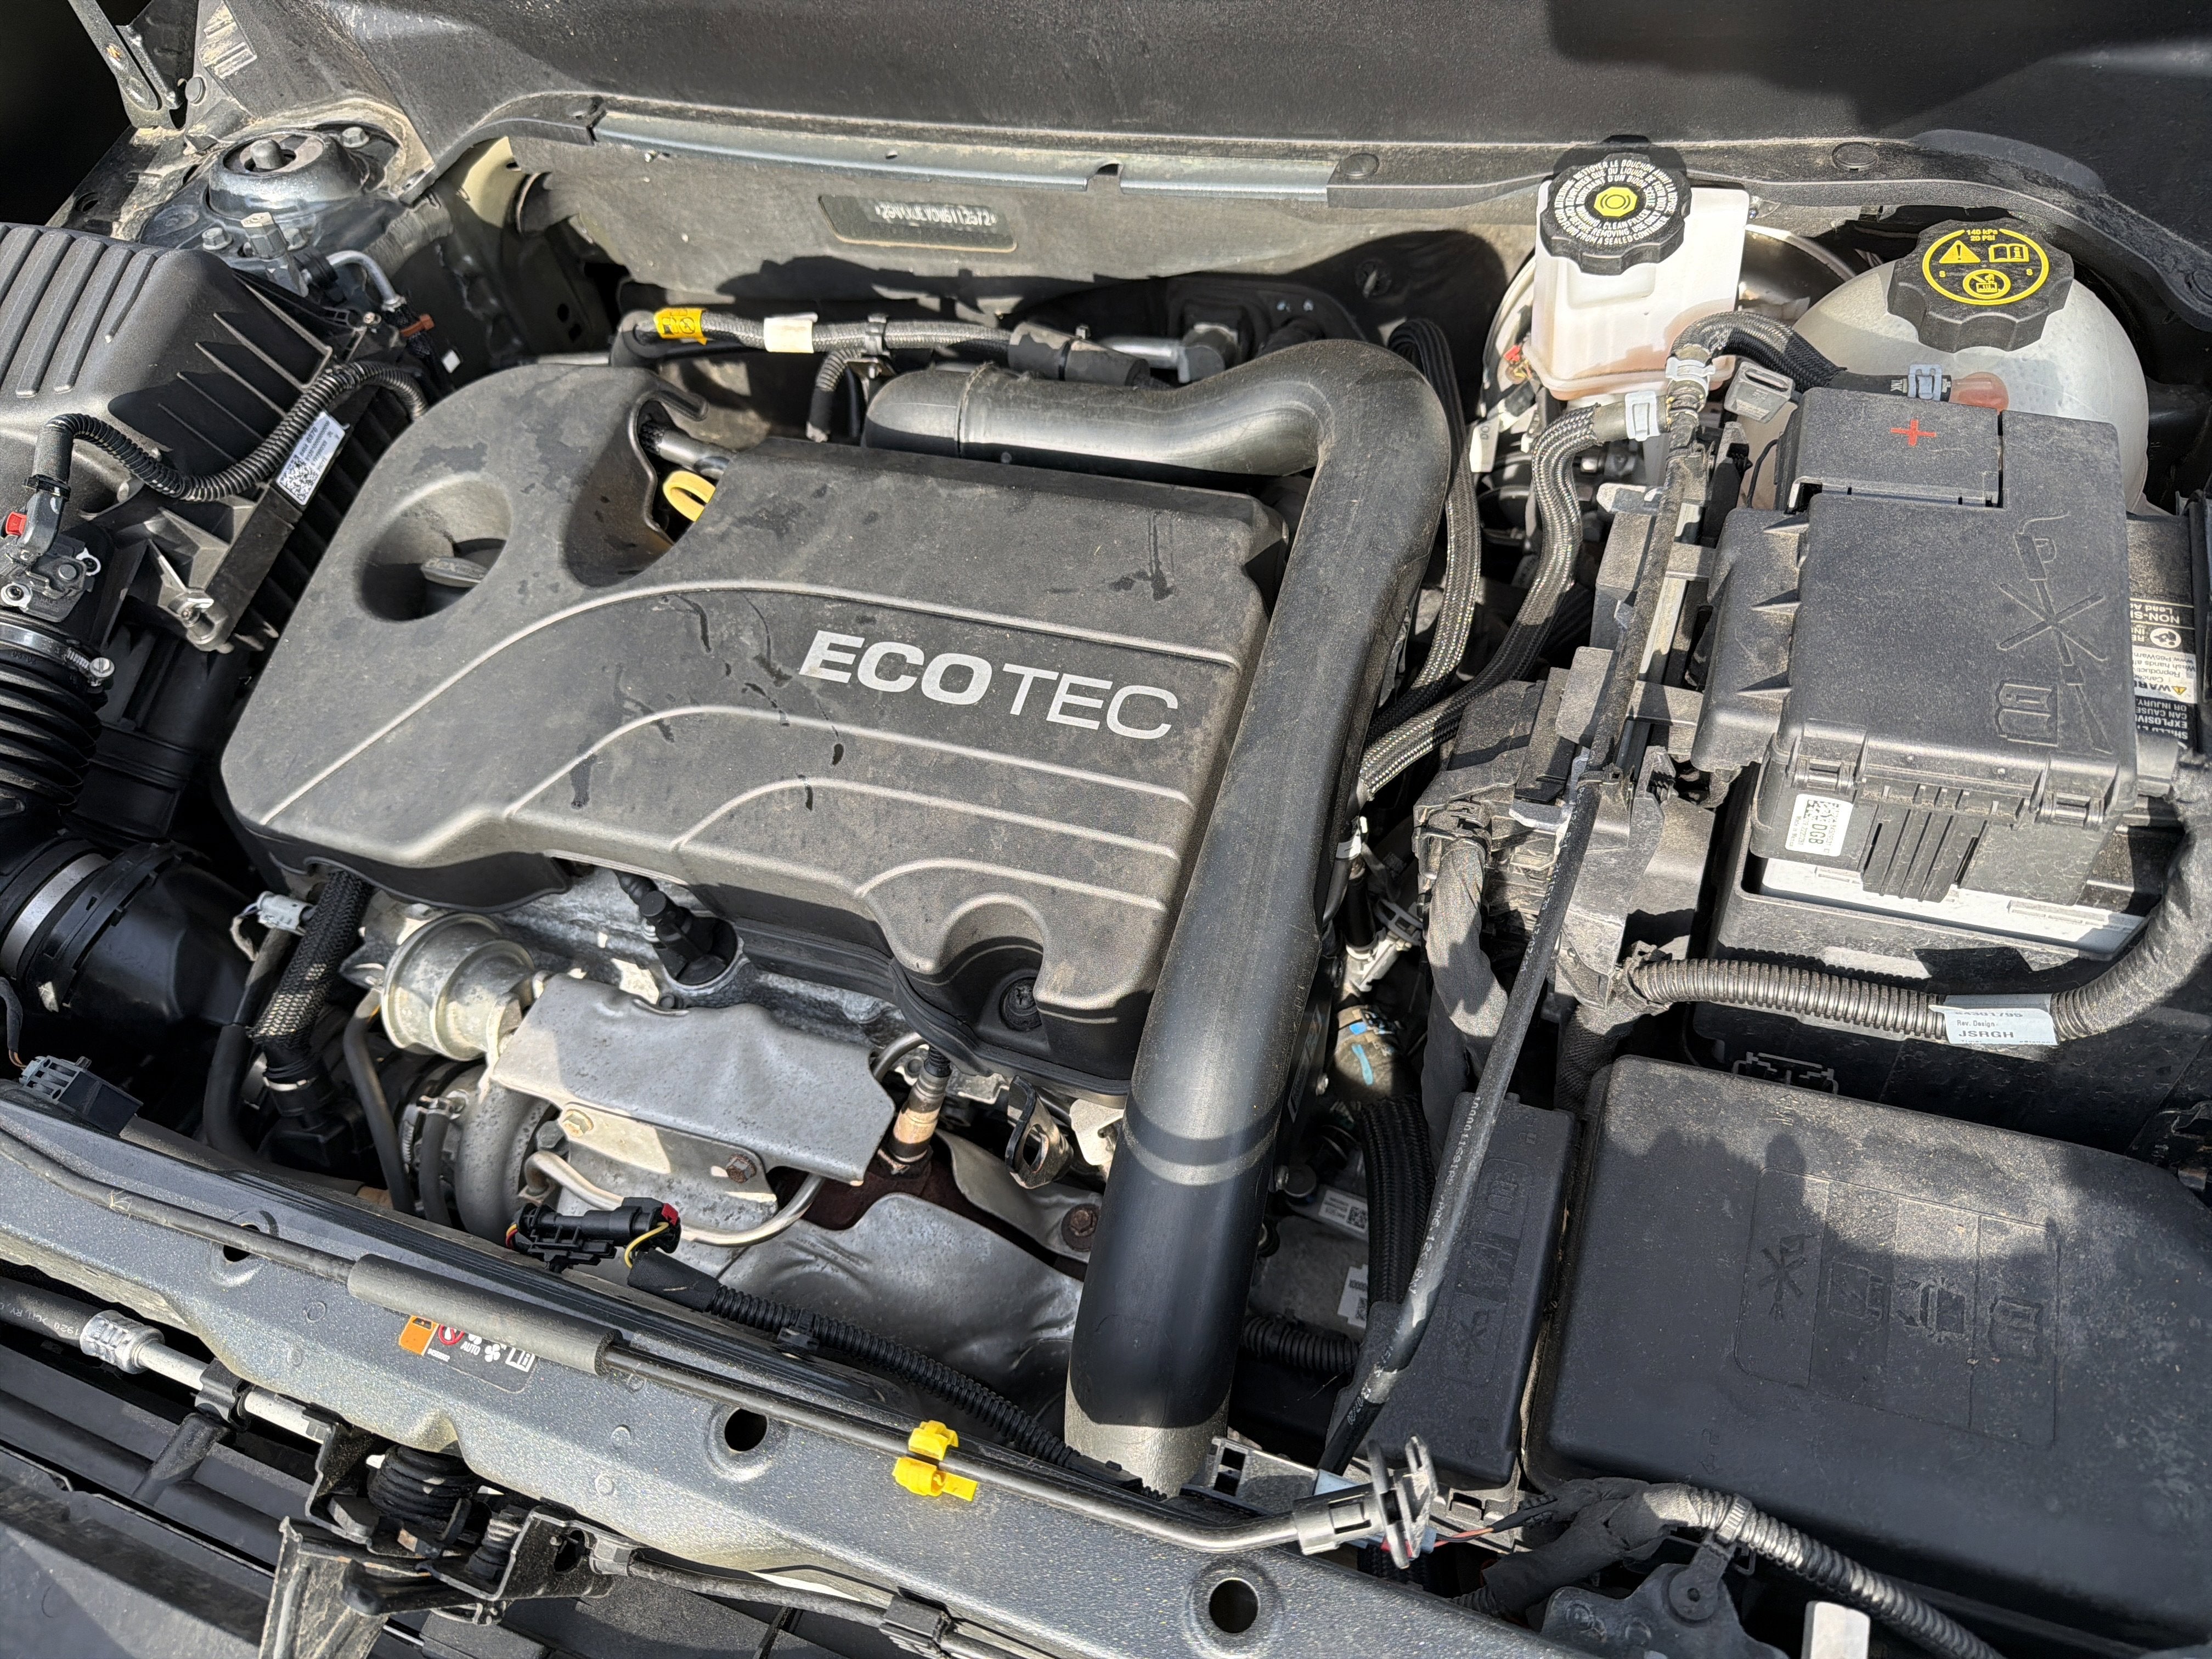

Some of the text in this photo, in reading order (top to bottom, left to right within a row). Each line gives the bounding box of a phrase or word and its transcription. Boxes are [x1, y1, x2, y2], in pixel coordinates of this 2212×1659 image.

[1571, 162, 1608, 180] NETTOYER
[1621, 158, 1655, 173] BOUCHON
[1651, 169, 1672, 184] AVANT
[1664, 183, 1676, 191] LA
[1589, 170, 1606, 179] QUE
[1620, 166, 1647, 179] LIQUIDE
[1644, 174, 1656, 183] DE
[1650, 181, 1666, 196] FREIN
[1576, 176, 1606, 204] PROVENANT
[1626, 175, 1648, 188] BIDON
[1565, 206, 1577, 217] CAP
[1602, 221, 1629, 229] CLEAN
[1627, 208, 1652, 227] FILLER
[1643, 210, 1661, 225] ONLY
[1569, 216, 1593, 233] BEFORE
[1631, 222, 1648, 232] USE
[1560, 221, 1580, 236] FLUID
[1575, 231, 1598, 244] FROM
[1596, 236, 1603, 245] A
[1603, 235, 1635, 245] SEALED
[1889, 379, 1903, 392] TNK
[2145, 605, 2172, 614] Lead
[2145, 661, 2169, 669] hands
[2172, 663, 2194, 672] Wash
[799, 630, 1178, 740] ECOTEC
[2135, 698, 2170, 709] INJURY.
[2135, 707, 2187, 719] CAN CAUSE
[1808, 823, 1827, 844] DGB
[1959, 1030, 2014, 1038] JSRGH
[460, 1341, 481, 1356] AUTO
